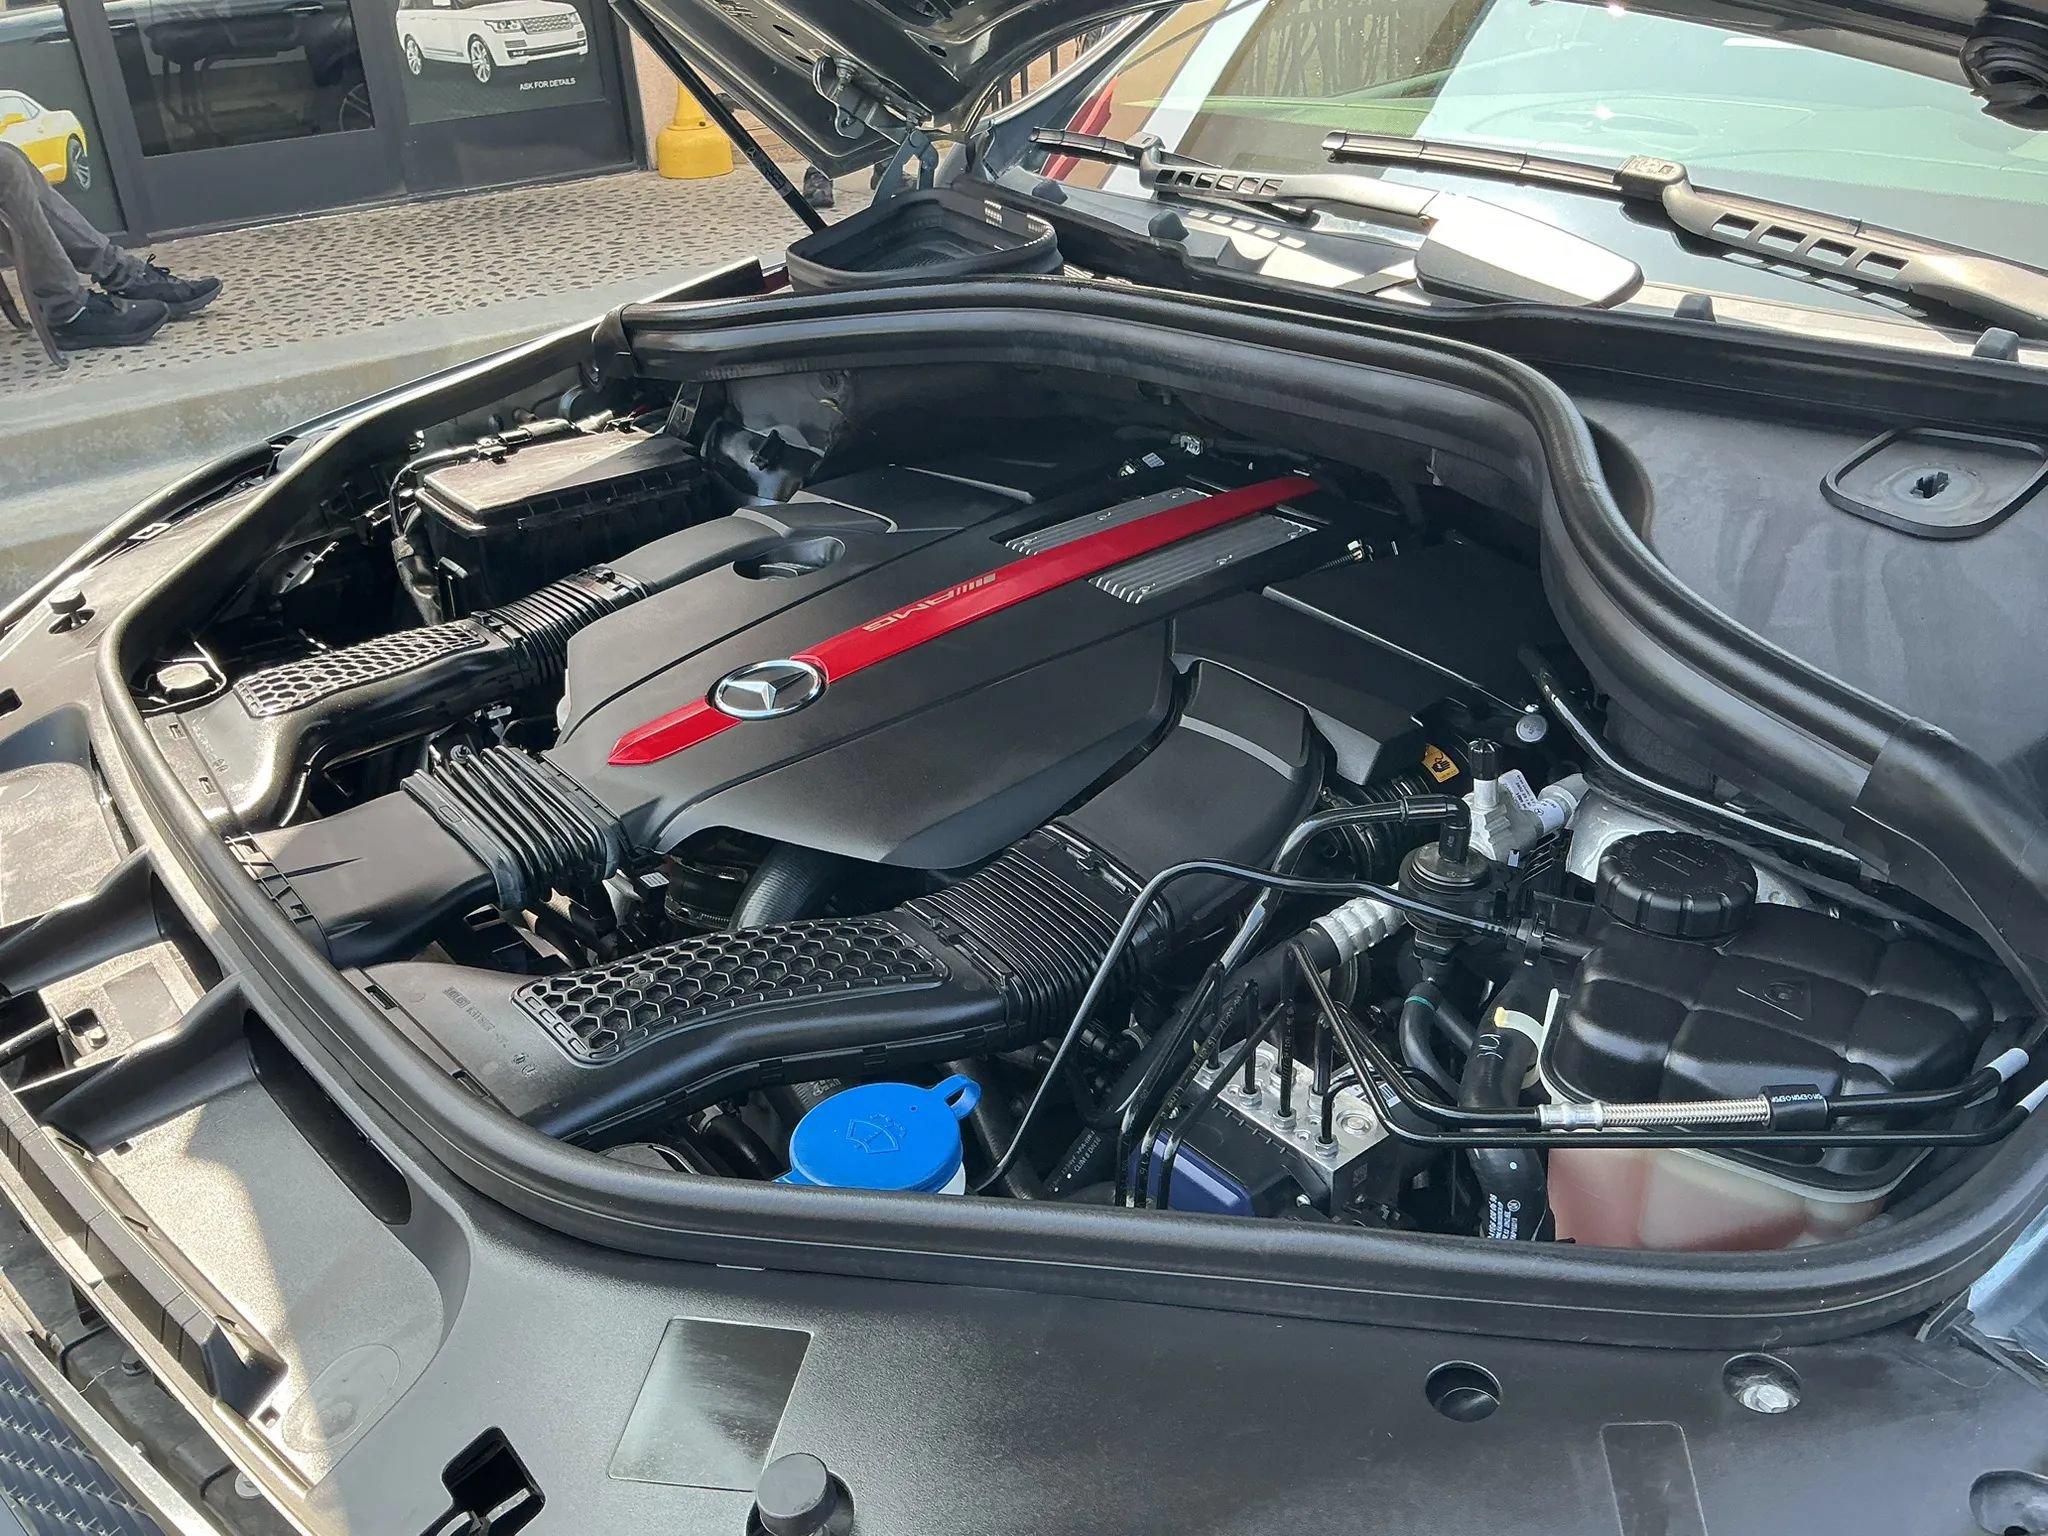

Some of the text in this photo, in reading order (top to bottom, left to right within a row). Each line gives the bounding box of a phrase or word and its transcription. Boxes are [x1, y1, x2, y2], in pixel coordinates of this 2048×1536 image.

[519, 77, 576, 91] ASK FOR DETAILS
